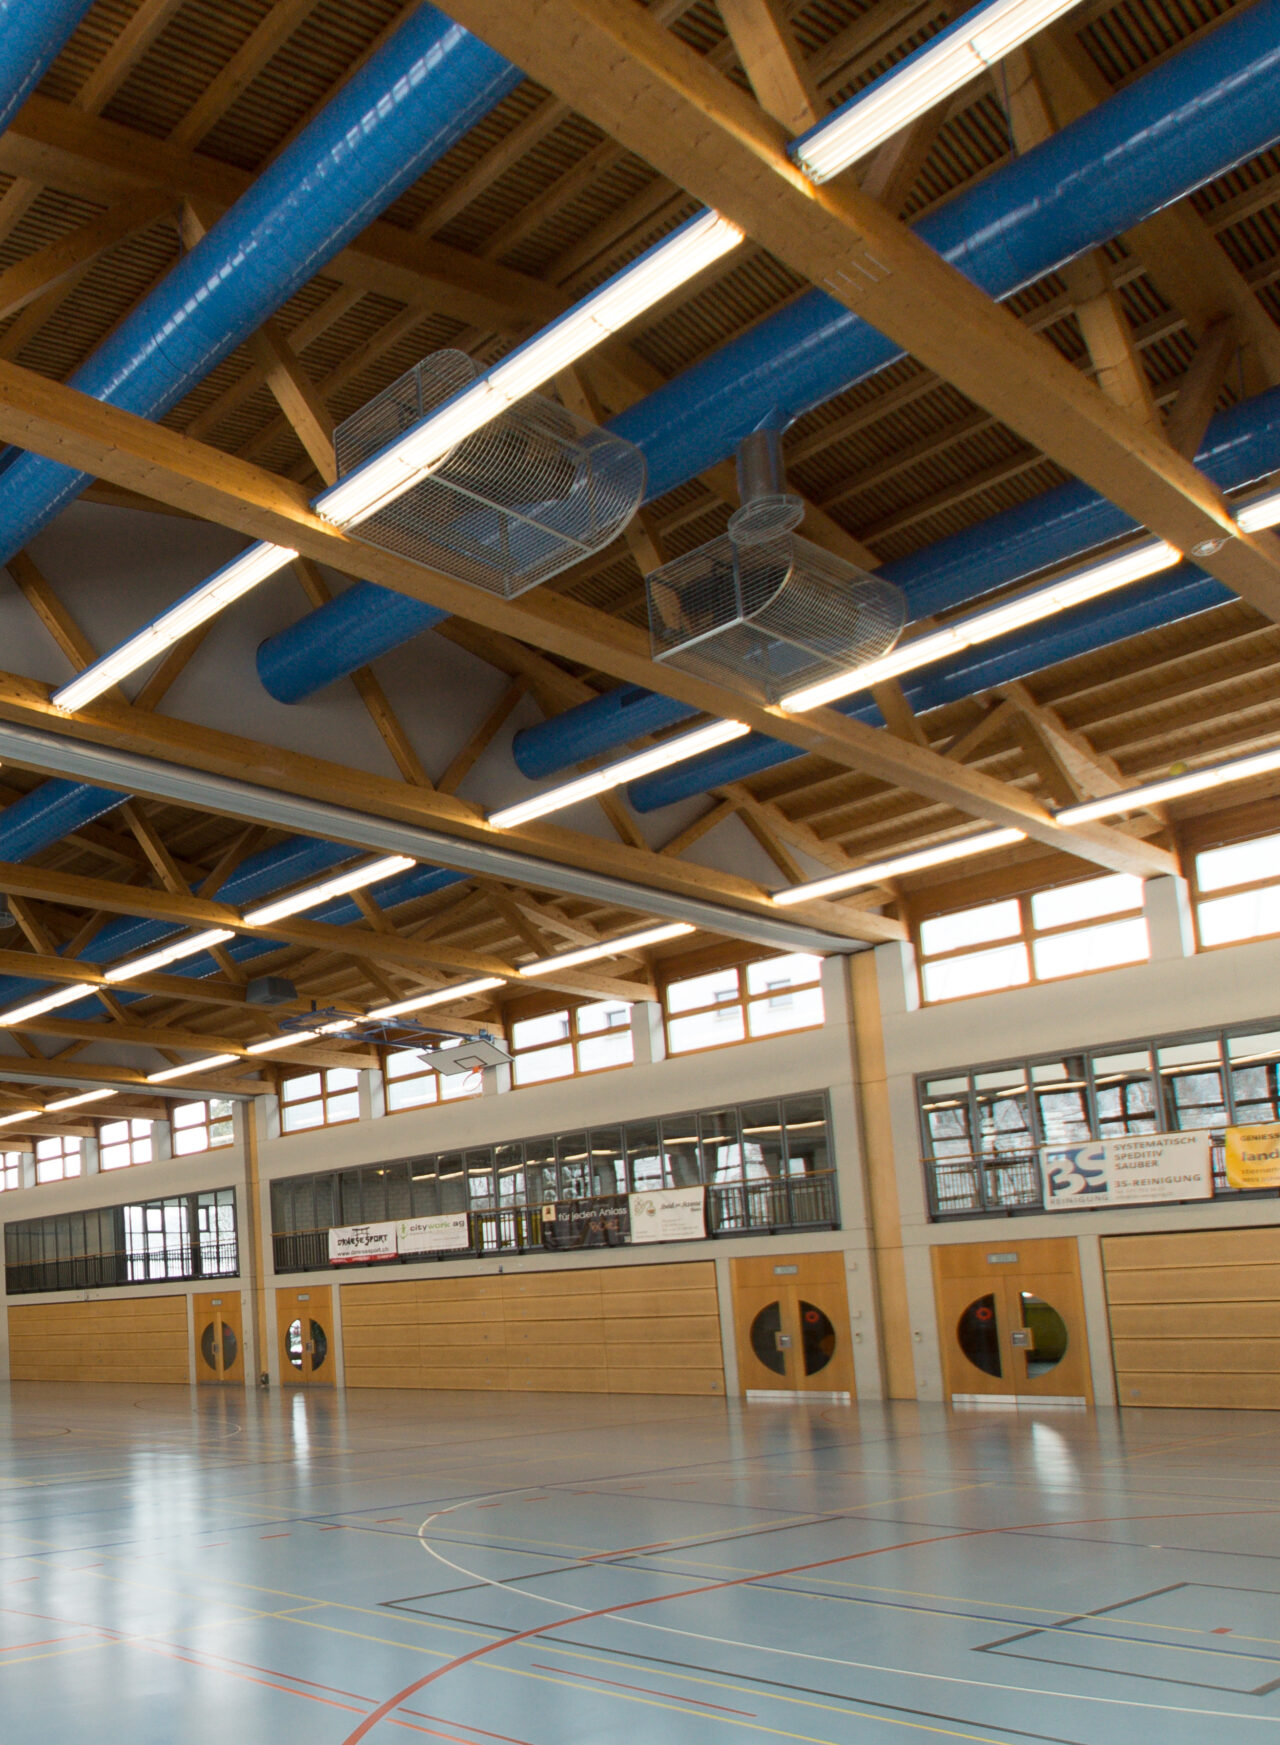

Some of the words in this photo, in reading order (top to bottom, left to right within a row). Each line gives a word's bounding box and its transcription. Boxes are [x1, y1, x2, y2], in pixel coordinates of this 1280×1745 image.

[1113, 1136, 1196, 1151] SYSTEMATISCH
[1114, 1150, 1163, 1161] SPEDITIV
[1114, 1159, 1158, 1170] SAUBER
[1114, 1173, 1202, 1188] 3S-REINIGUNG
[1050, 1194, 1109, 1206] REINIGUNG
